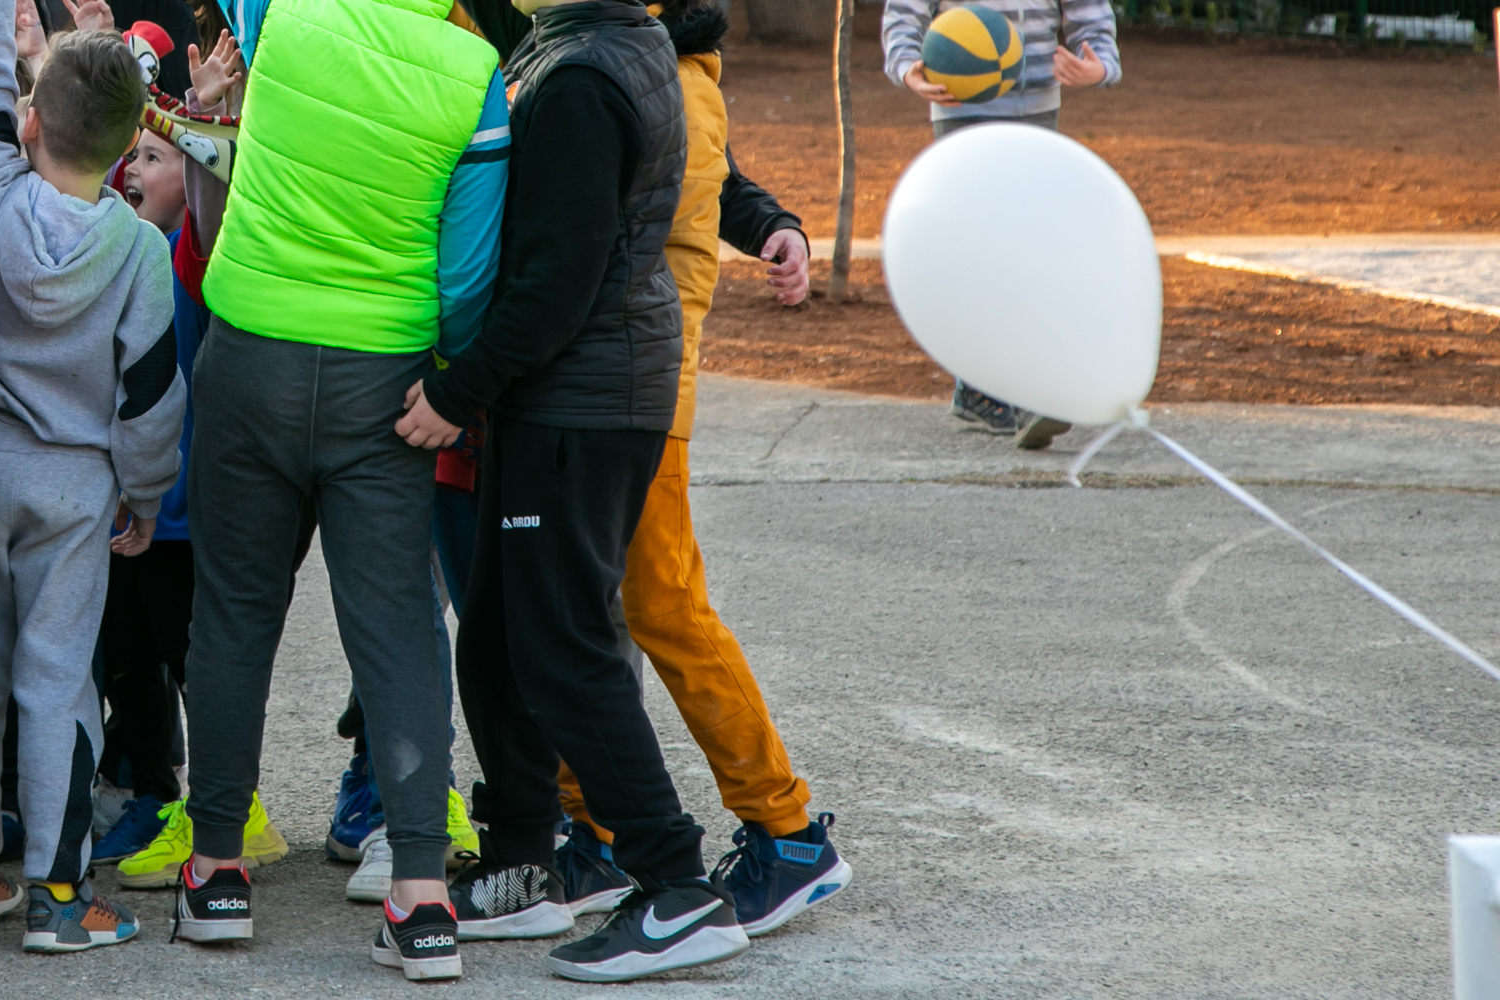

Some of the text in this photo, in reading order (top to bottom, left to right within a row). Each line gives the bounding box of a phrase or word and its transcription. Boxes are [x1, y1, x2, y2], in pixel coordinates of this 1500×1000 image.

[782, 843, 816, 860] PUMA
[207, 898, 248, 910] adidas
[414, 934, 455, 949] adidas
